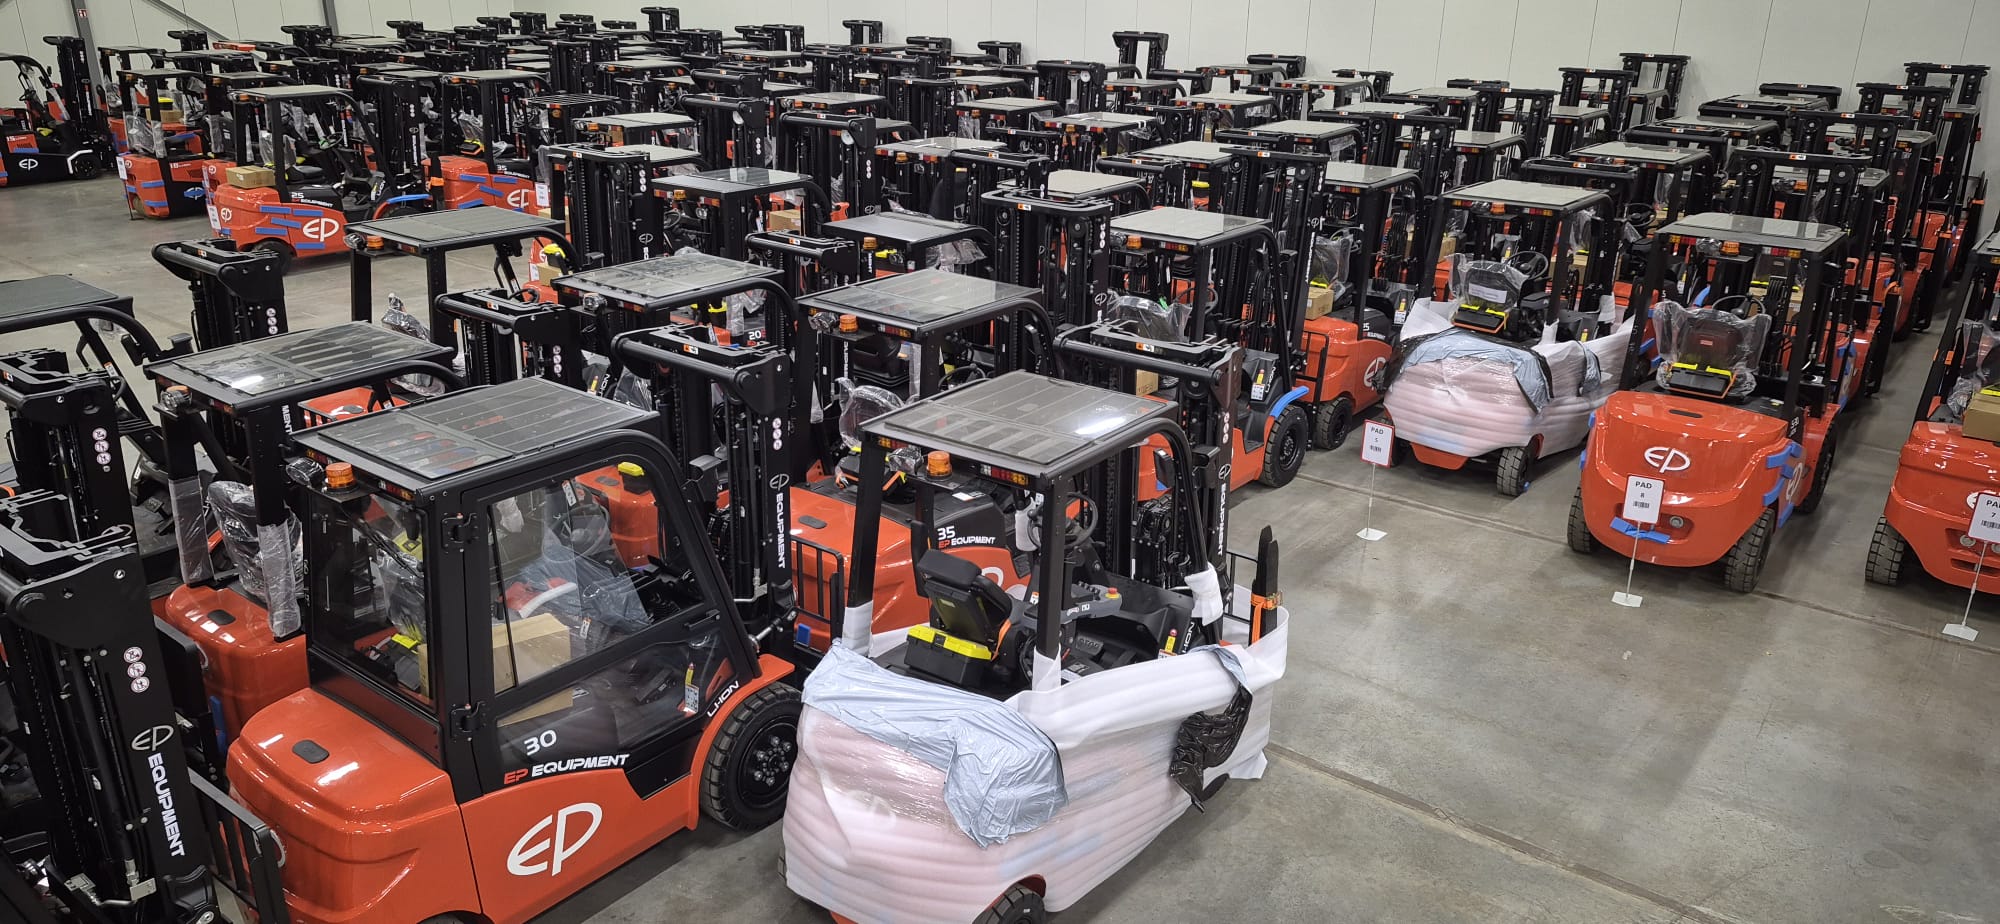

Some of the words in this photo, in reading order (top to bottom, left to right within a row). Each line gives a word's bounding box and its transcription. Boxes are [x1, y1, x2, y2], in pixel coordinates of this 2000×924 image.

[19, 158, 38, 170] EP
[303, 218, 340, 242] EP
[639, 233, 653, 245] EP
[1371, 427, 1384, 435] PAD
[1644, 447, 1690, 473] EP
[769, 473, 789, 490] EP
[1635, 481, 1652, 489] PAD
[776, 493, 786, 568] EQUIPMENT
[1218, 483, 1226, 556] EQUIPMENT
[937, 526, 956, 540] 35
[938, 538, 951, 549] EP
[951, 536, 996, 546] EQUIPMENT
[707, 680, 739, 718] LI-ION
[131, 725, 174, 752] EP
[524, 730, 557, 756] 30
[504, 768, 528, 785] EP
[531, 754, 629, 777] EQUIPMENT
[148, 752, 186, 857] EQUIPMENT
[506, 802, 603, 877] EP
